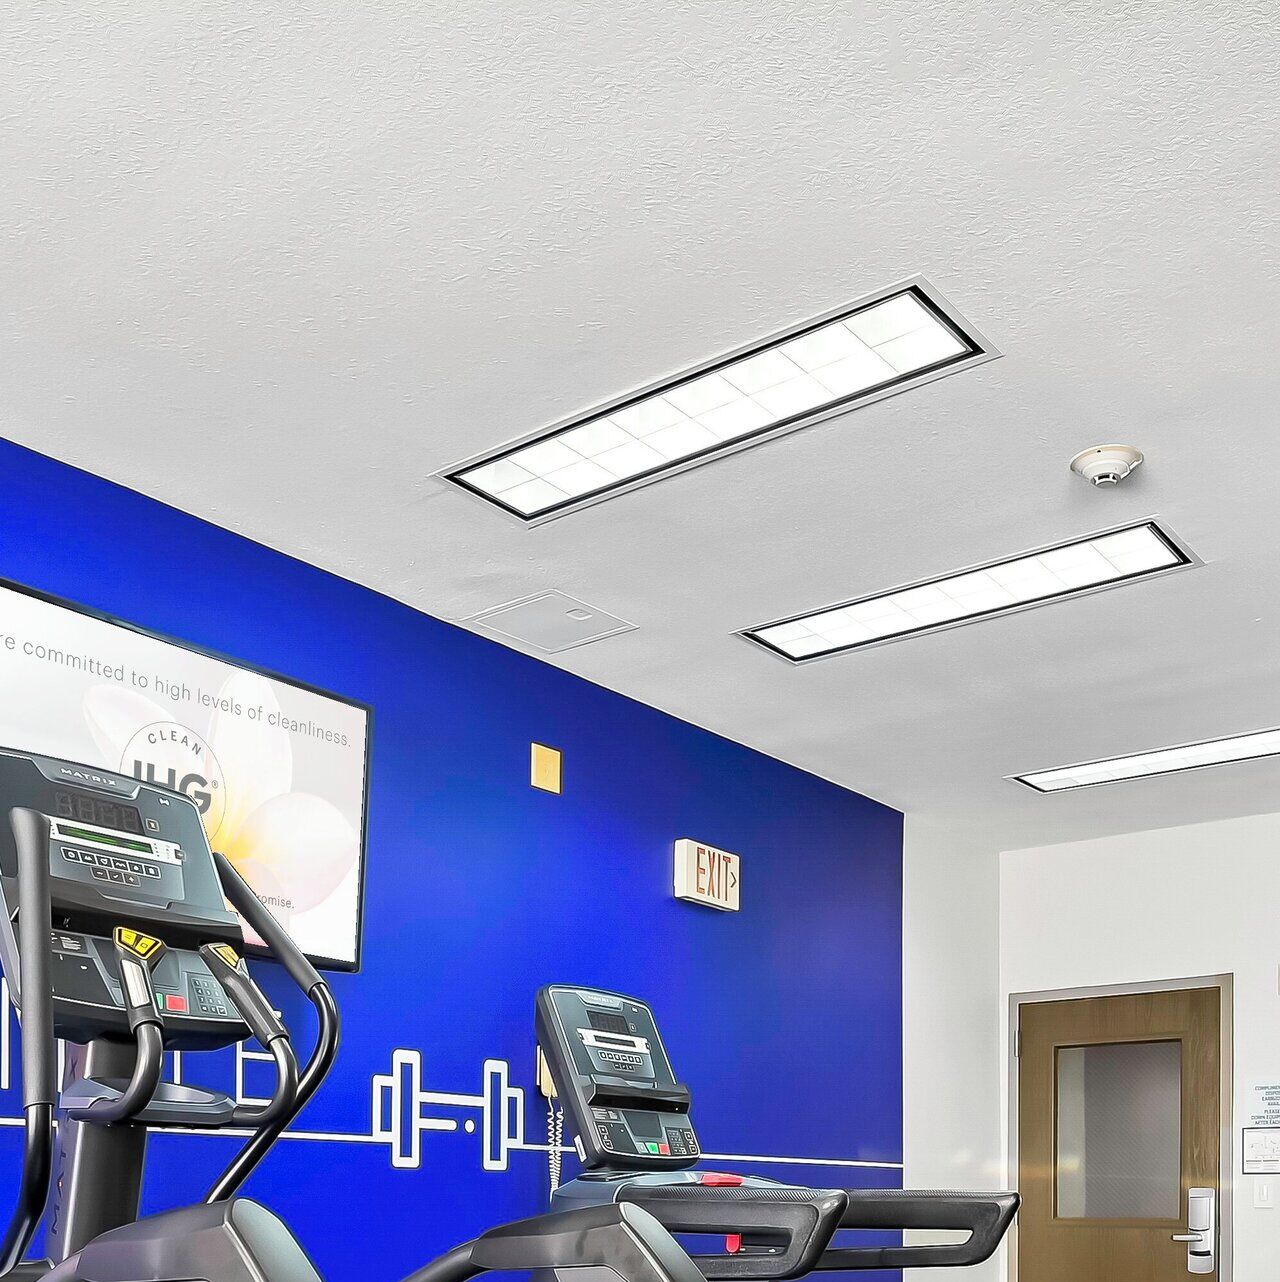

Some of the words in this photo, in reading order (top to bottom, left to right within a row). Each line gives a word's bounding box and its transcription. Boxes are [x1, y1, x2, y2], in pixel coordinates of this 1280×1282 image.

[23, 642, 125, 681] committed
[132, 670, 148, 688] to
[155, 676, 191, 701] high
[197, 688, 242, 715] levels
[247, 706, 264, 721] of
[268, 712, 351, 747] cleanliness.
[147, 730, 202, 755] CLEAN
[61, 768, 117, 786] MATRIX
[696, 847, 731, 901] EXIT
